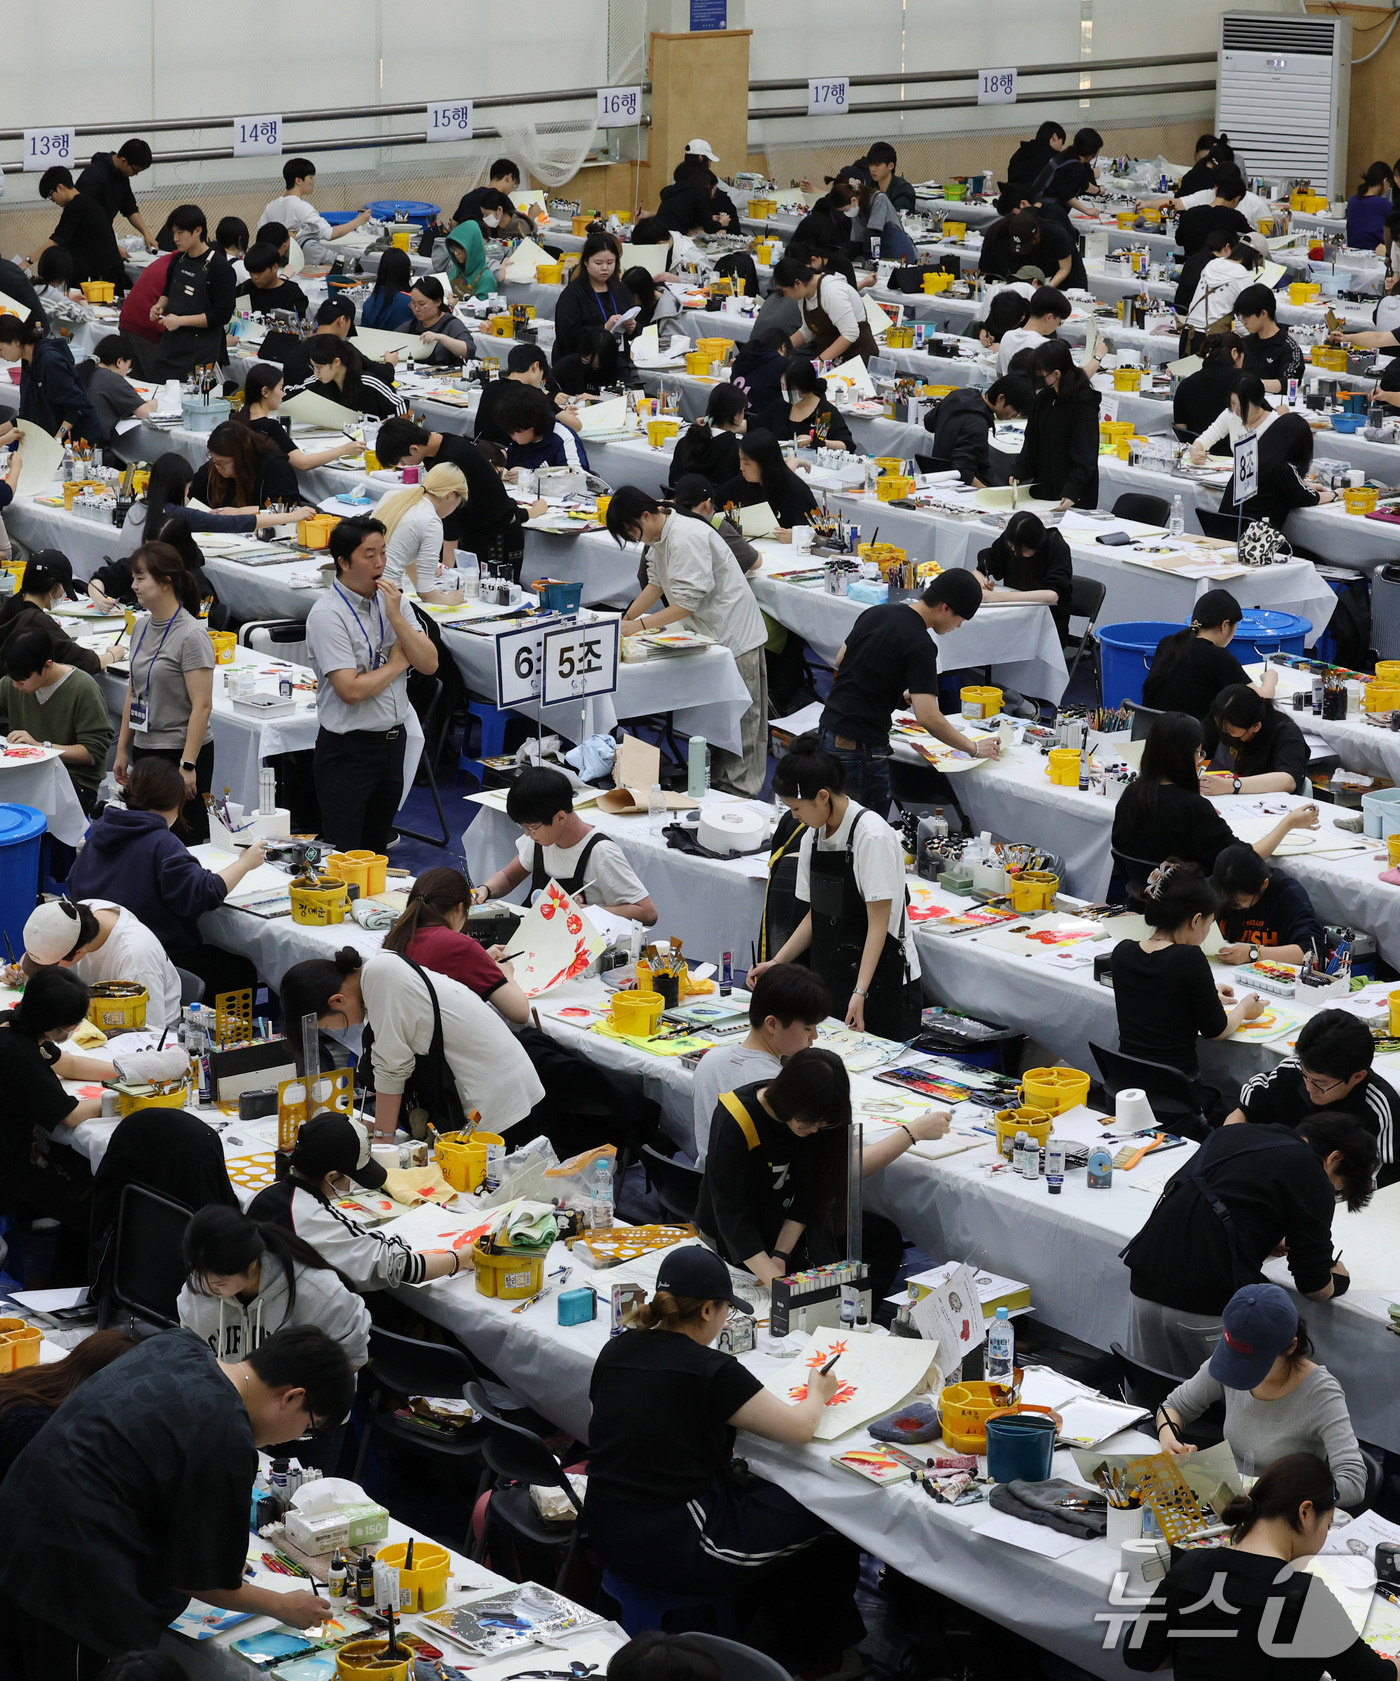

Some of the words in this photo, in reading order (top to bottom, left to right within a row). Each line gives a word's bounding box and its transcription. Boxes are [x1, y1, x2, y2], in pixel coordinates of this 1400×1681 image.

[814, 83, 845, 105] 17행
[983, 74, 1013, 95] 18행
[603, 92, 637, 116] 16행
[432, 106, 468, 129] 15행
[240, 121, 278, 145] 14행
[30, 134, 70, 158] 13행
[1240, 450, 1254, 482] 8조
[515, 641, 542, 679] 6
[558, 639, 603, 679] 5조
